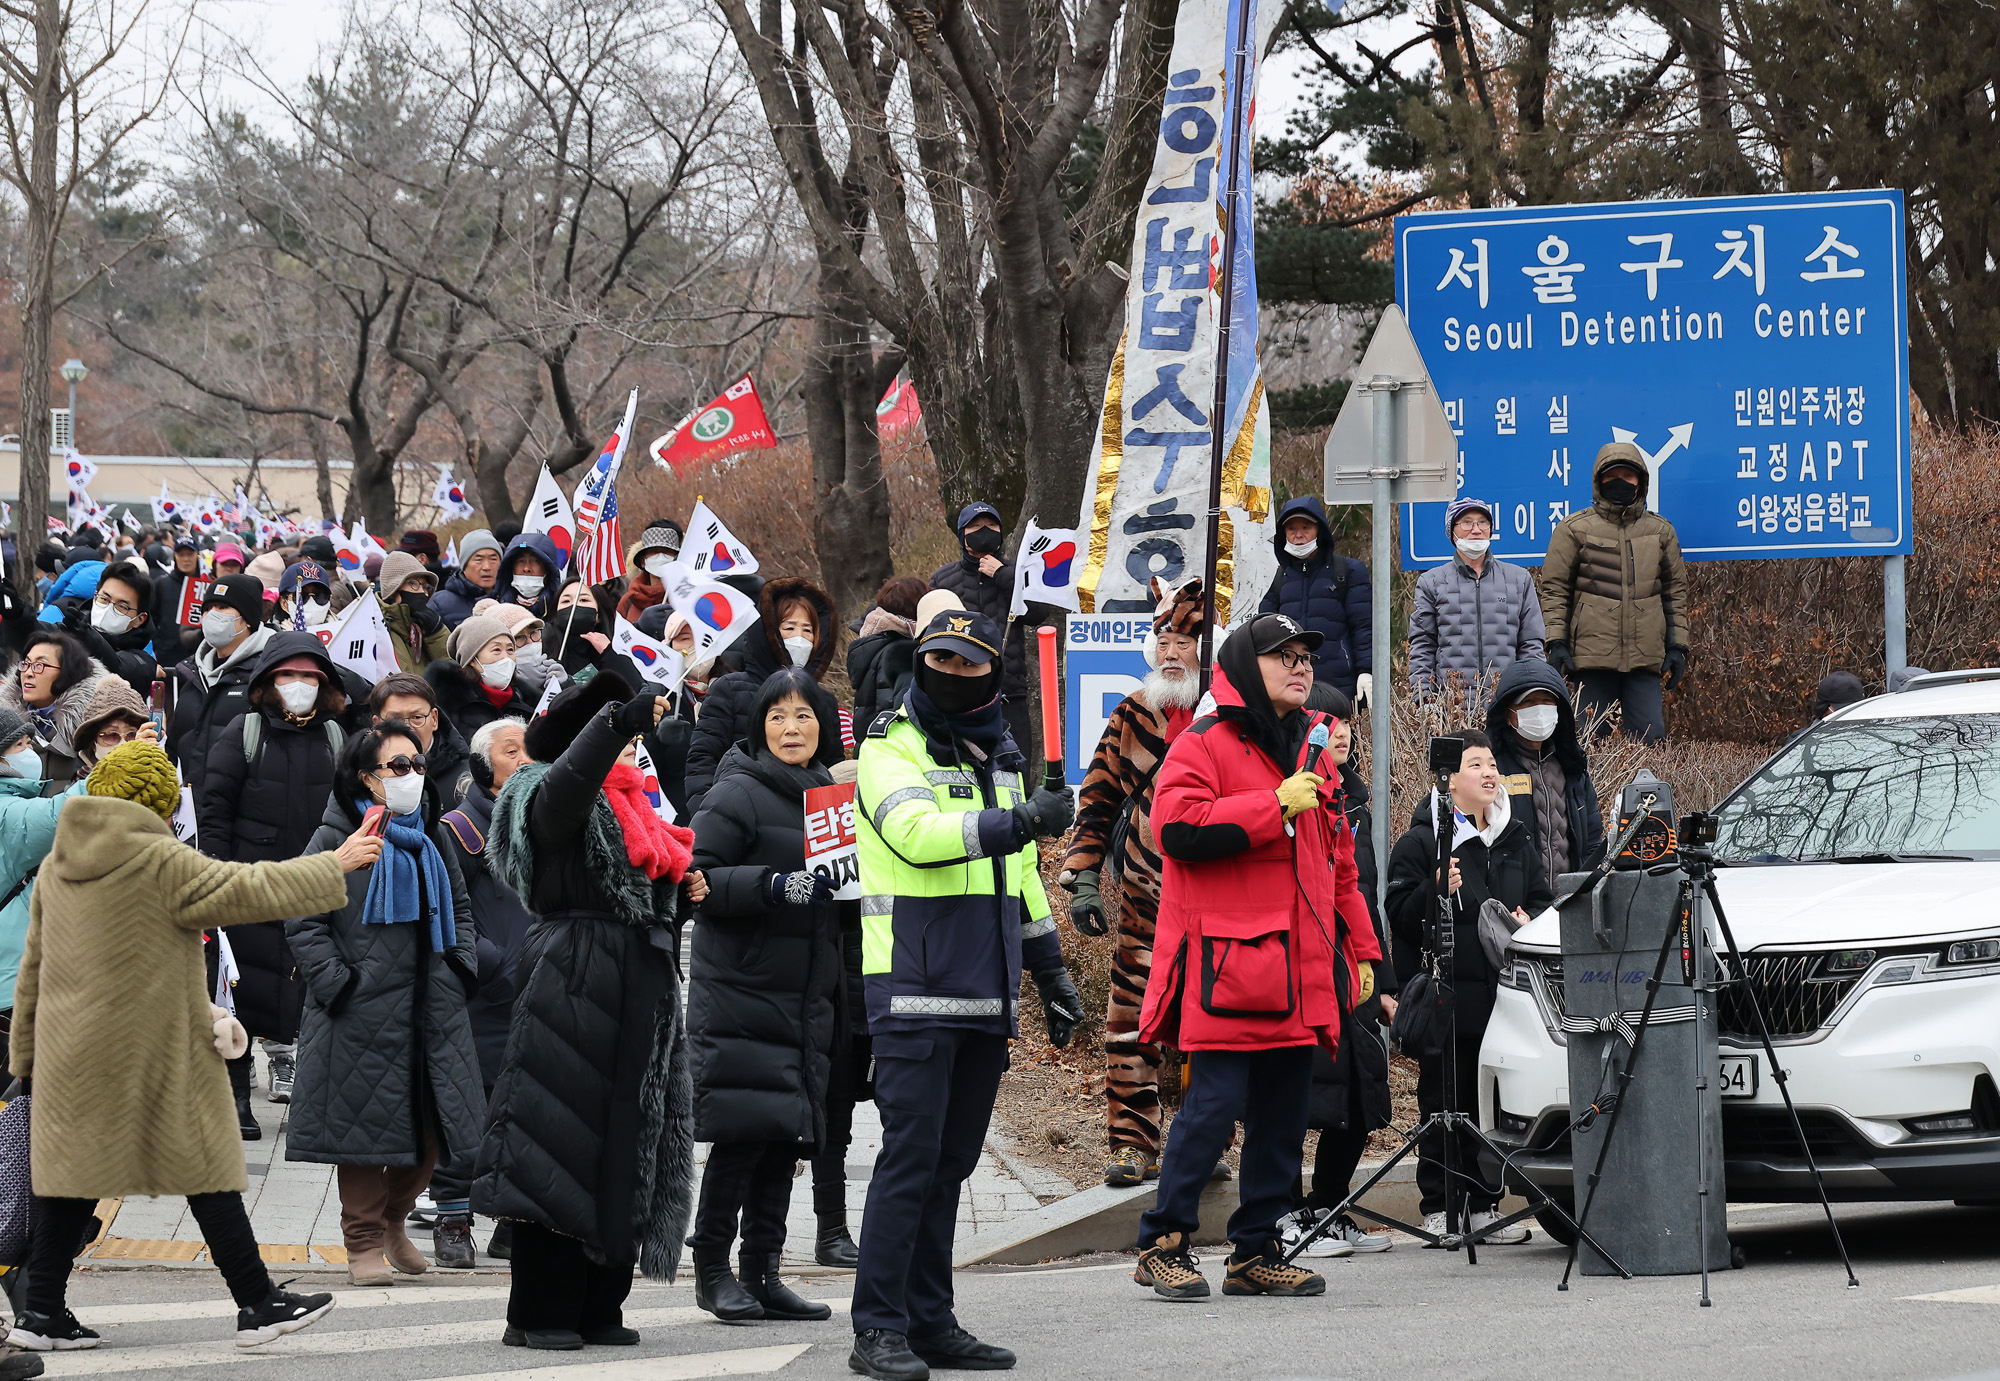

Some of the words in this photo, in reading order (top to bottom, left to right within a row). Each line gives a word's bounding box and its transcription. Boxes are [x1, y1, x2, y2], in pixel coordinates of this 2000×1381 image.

[1436, 224, 1866, 310] 서울구치소
[1443, 313, 1533, 352] Seoul
[1560, 305, 1724, 347] Detention
[1754, 302, 1867, 339] Center
[1734, 385, 1866, 427] 민원인주차장
[1737, 491, 1872, 534] 의왕정음학교
